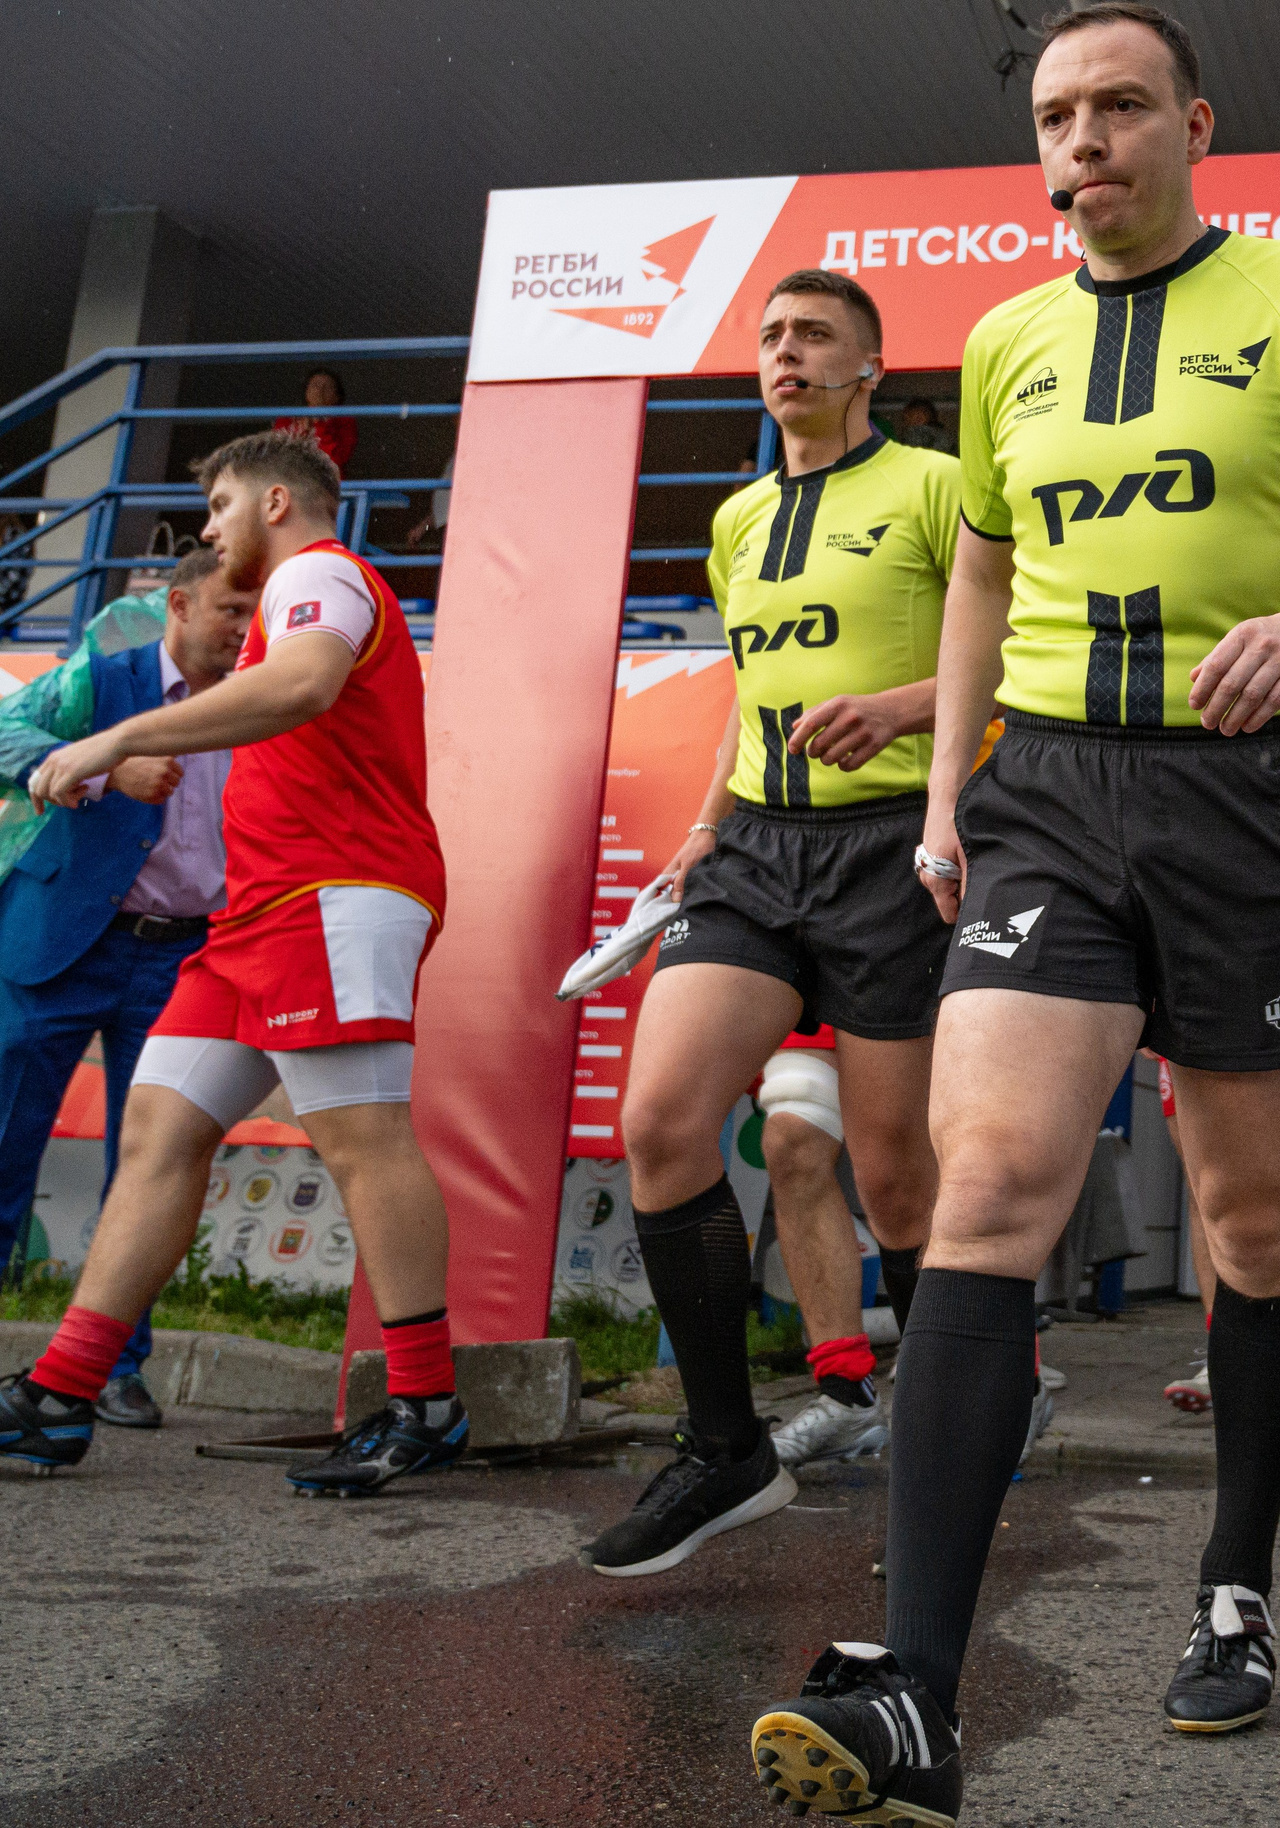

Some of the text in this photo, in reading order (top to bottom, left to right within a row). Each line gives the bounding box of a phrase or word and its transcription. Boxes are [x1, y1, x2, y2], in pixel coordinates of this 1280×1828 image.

[514, 253, 599, 275] РЕГБИ
[511, 276, 625, 300] РОССИИ
[622, 312, 655, 327] 1892
[1180, 354, 1220, 365] РЕГБИ
[1179, 364, 1233, 375] РОССИИ
[826, 540, 861, 548] РОССИИ
[827, 533, 854, 541] РЕГБИ
[961, 920, 990, 937] РЕГБИ
[958, 931, 1001, 947] РОССИИ
